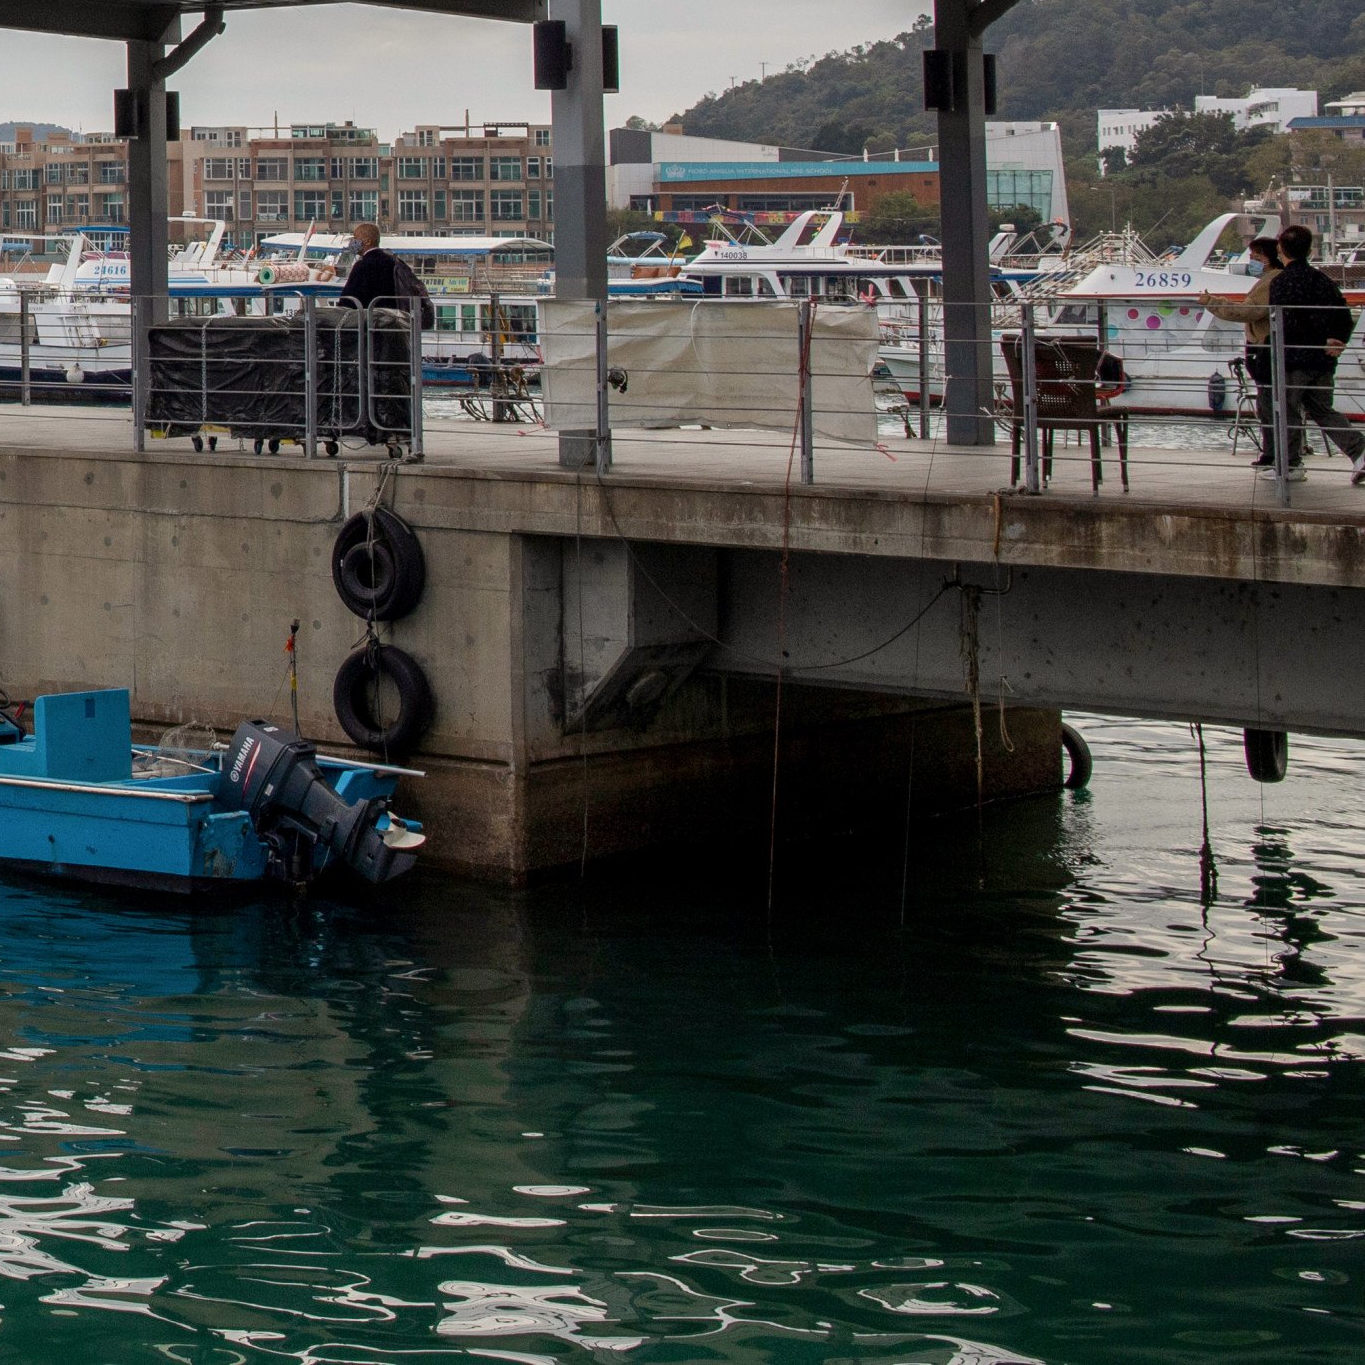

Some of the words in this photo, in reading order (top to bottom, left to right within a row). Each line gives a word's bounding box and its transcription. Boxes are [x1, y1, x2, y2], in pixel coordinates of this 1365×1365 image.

[720, 251, 748, 260] 140038
[1134, 272, 1192, 288] 26859
[232, 736, 255, 773] YAMAHA
